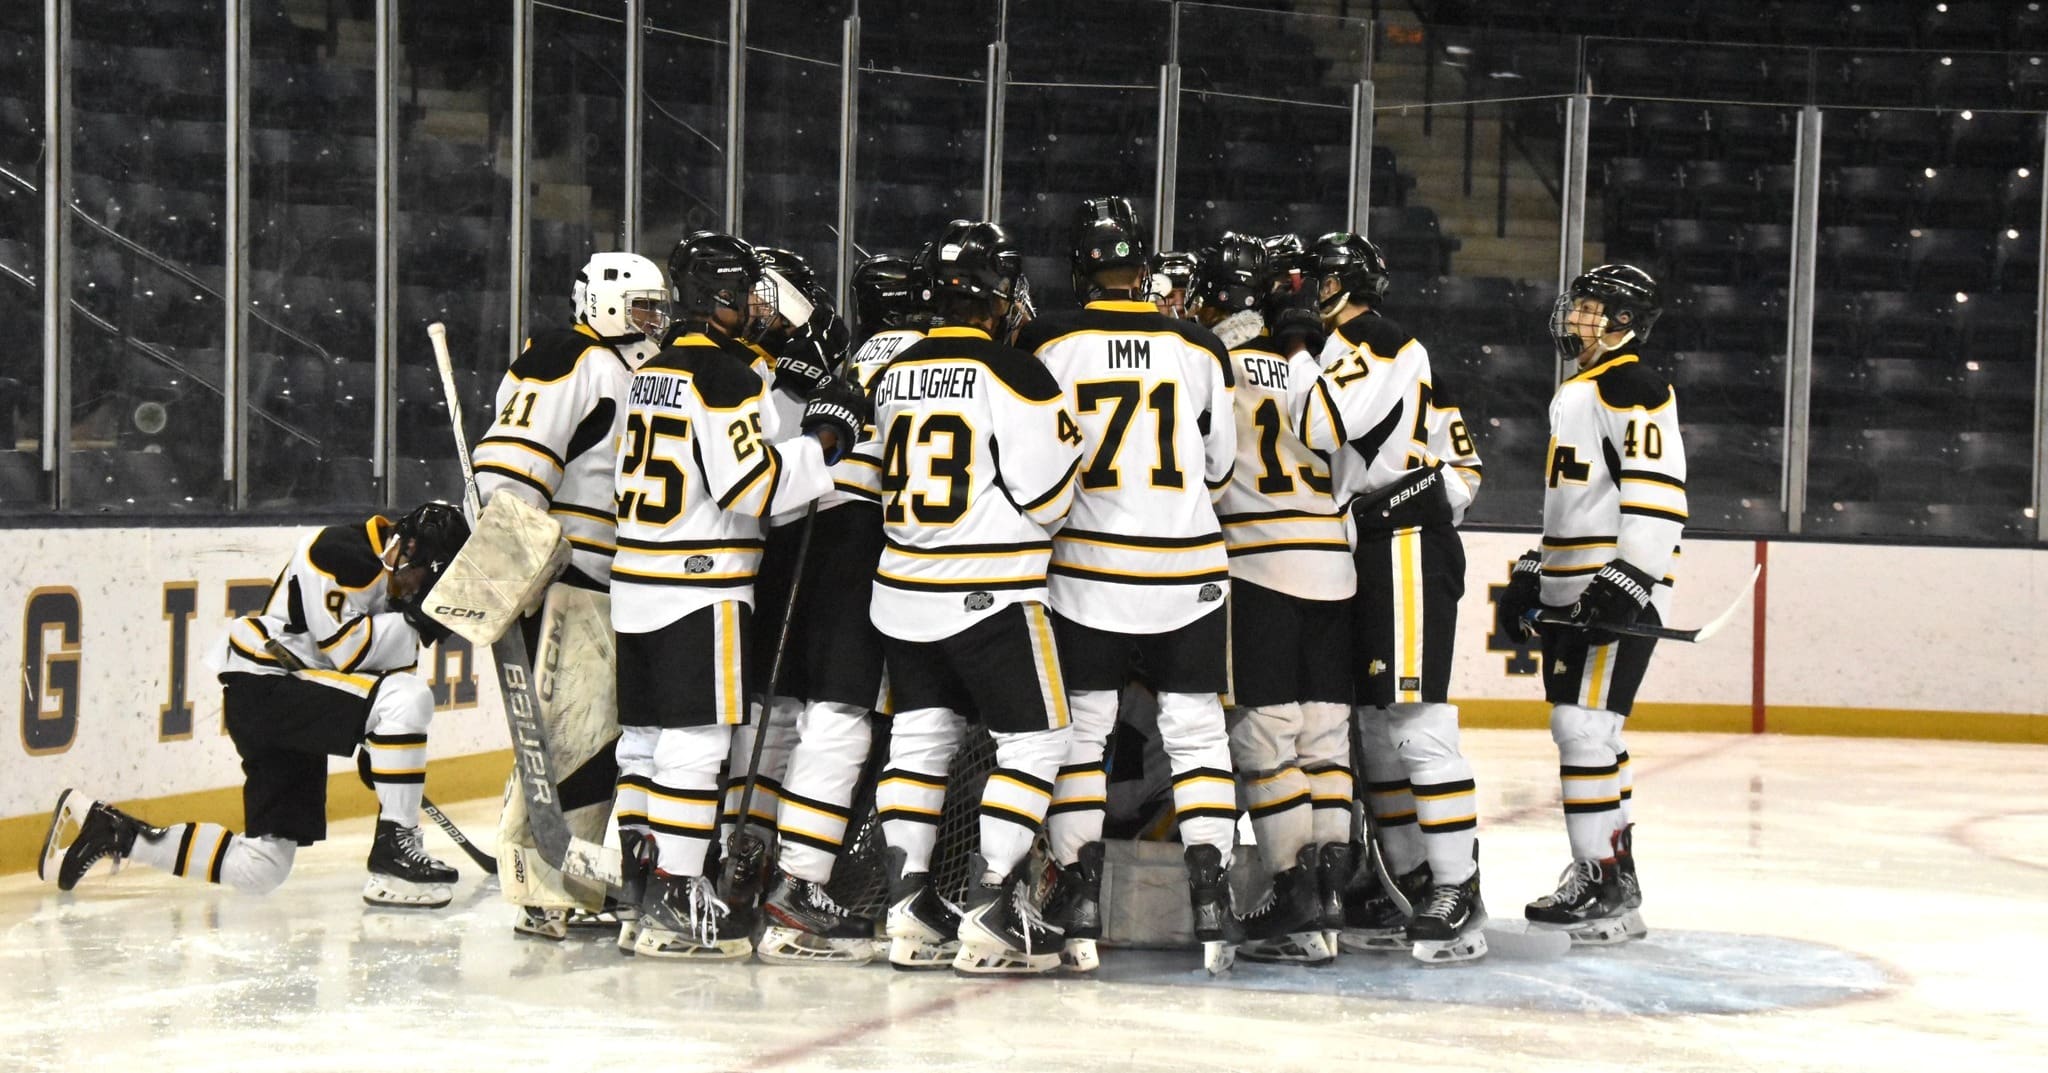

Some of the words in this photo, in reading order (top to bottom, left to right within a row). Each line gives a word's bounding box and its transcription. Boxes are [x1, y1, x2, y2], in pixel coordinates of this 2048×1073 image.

[776, 356, 823, 379] BAU
[855, 337, 903, 363] COSTA
[1107, 339, 1151, 370] IMM
[629, 376, 688, 409] PASQUALE
[878, 367, 977, 407] GALLAGHER
[1243, 357, 1289, 390] SCHE
[499, 390, 538, 428] 41
[1074, 378, 1186, 491] 71
[1449, 420, 1475, 457] 8
[1623, 418, 1663, 461] 40
[617, 410, 692, 528] 25
[882, 411, 975, 528] 43
[1389, 472, 1437, 508] BAUER
[434, 605, 486, 620] CCM
[540, 609, 567, 702] CCM
[503, 663, 552, 804] BAUER
[424, 806, 467, 845] BAUER
